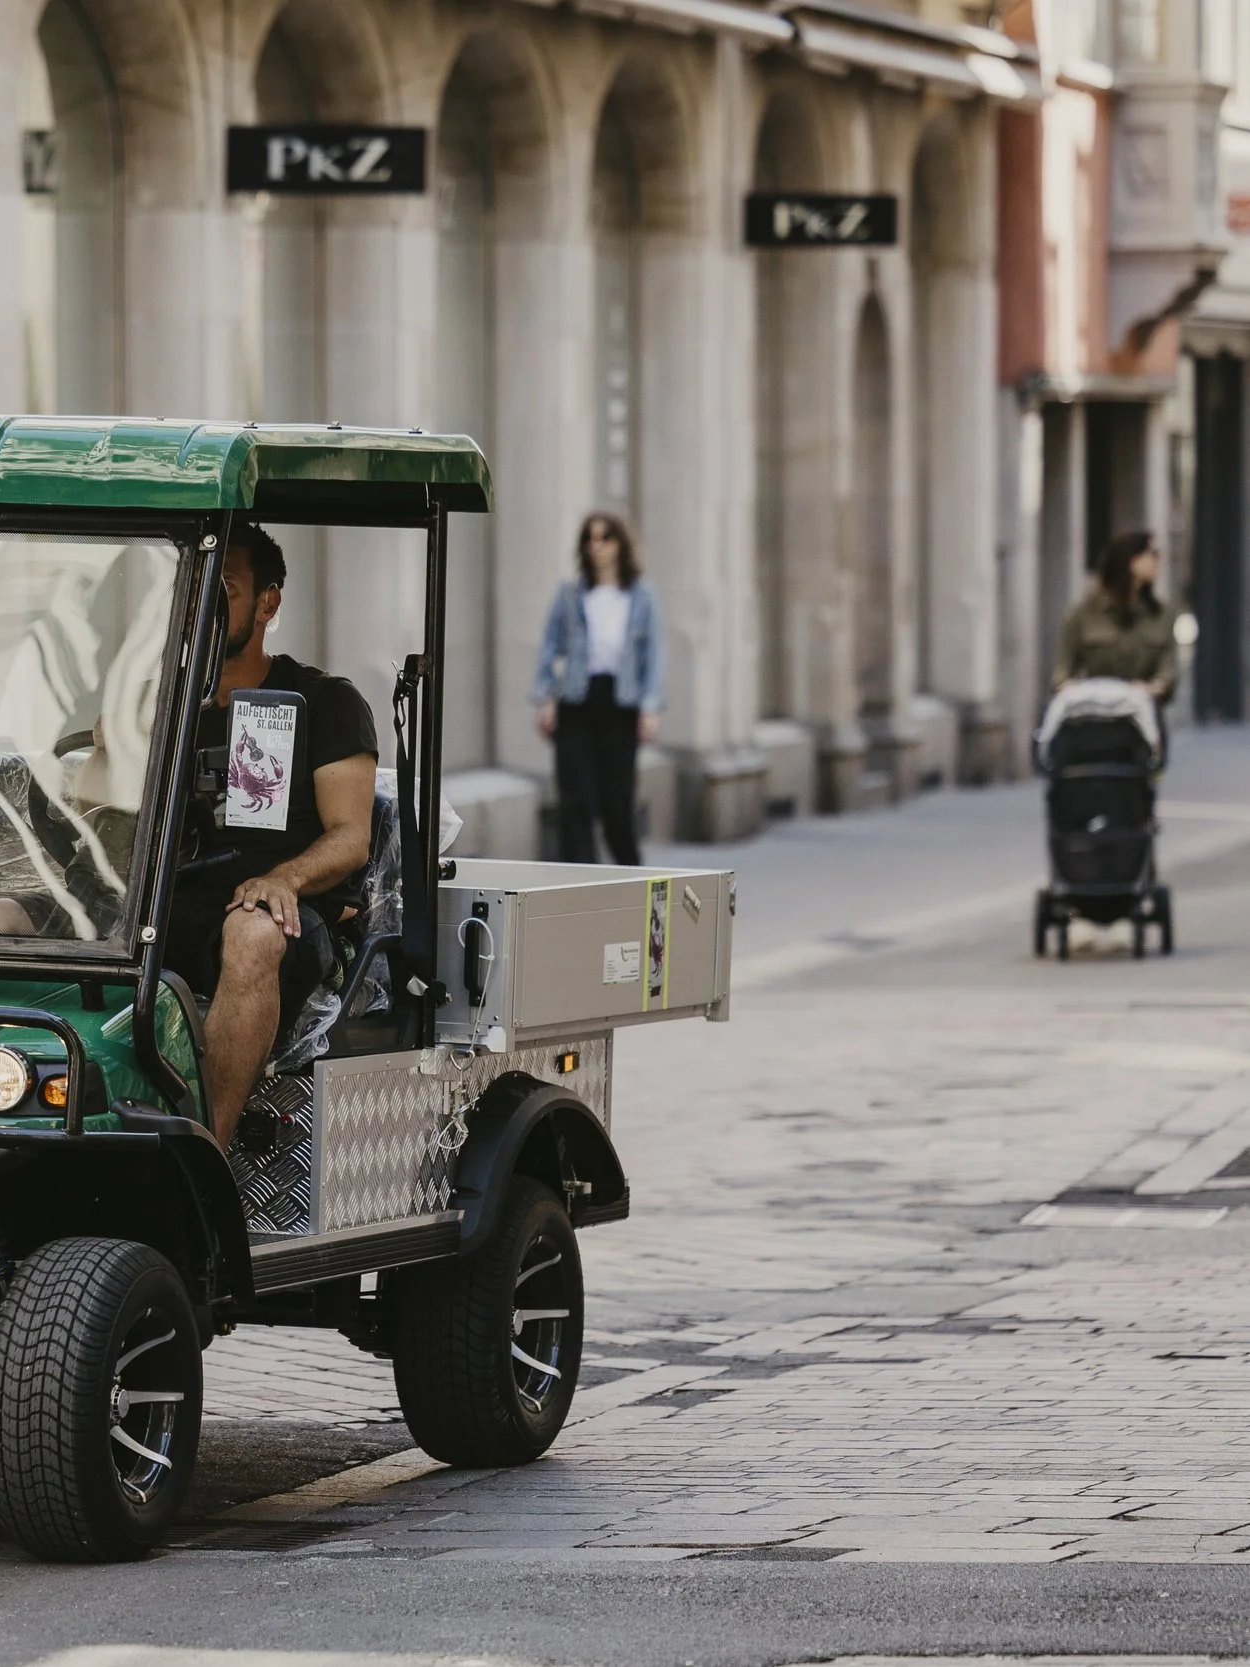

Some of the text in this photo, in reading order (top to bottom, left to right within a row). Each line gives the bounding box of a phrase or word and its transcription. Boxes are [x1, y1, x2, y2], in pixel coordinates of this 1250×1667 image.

[237, 704, 294, 720] AUFGETISCHT
[256, 719, 293, 731] ST. GALLEN
